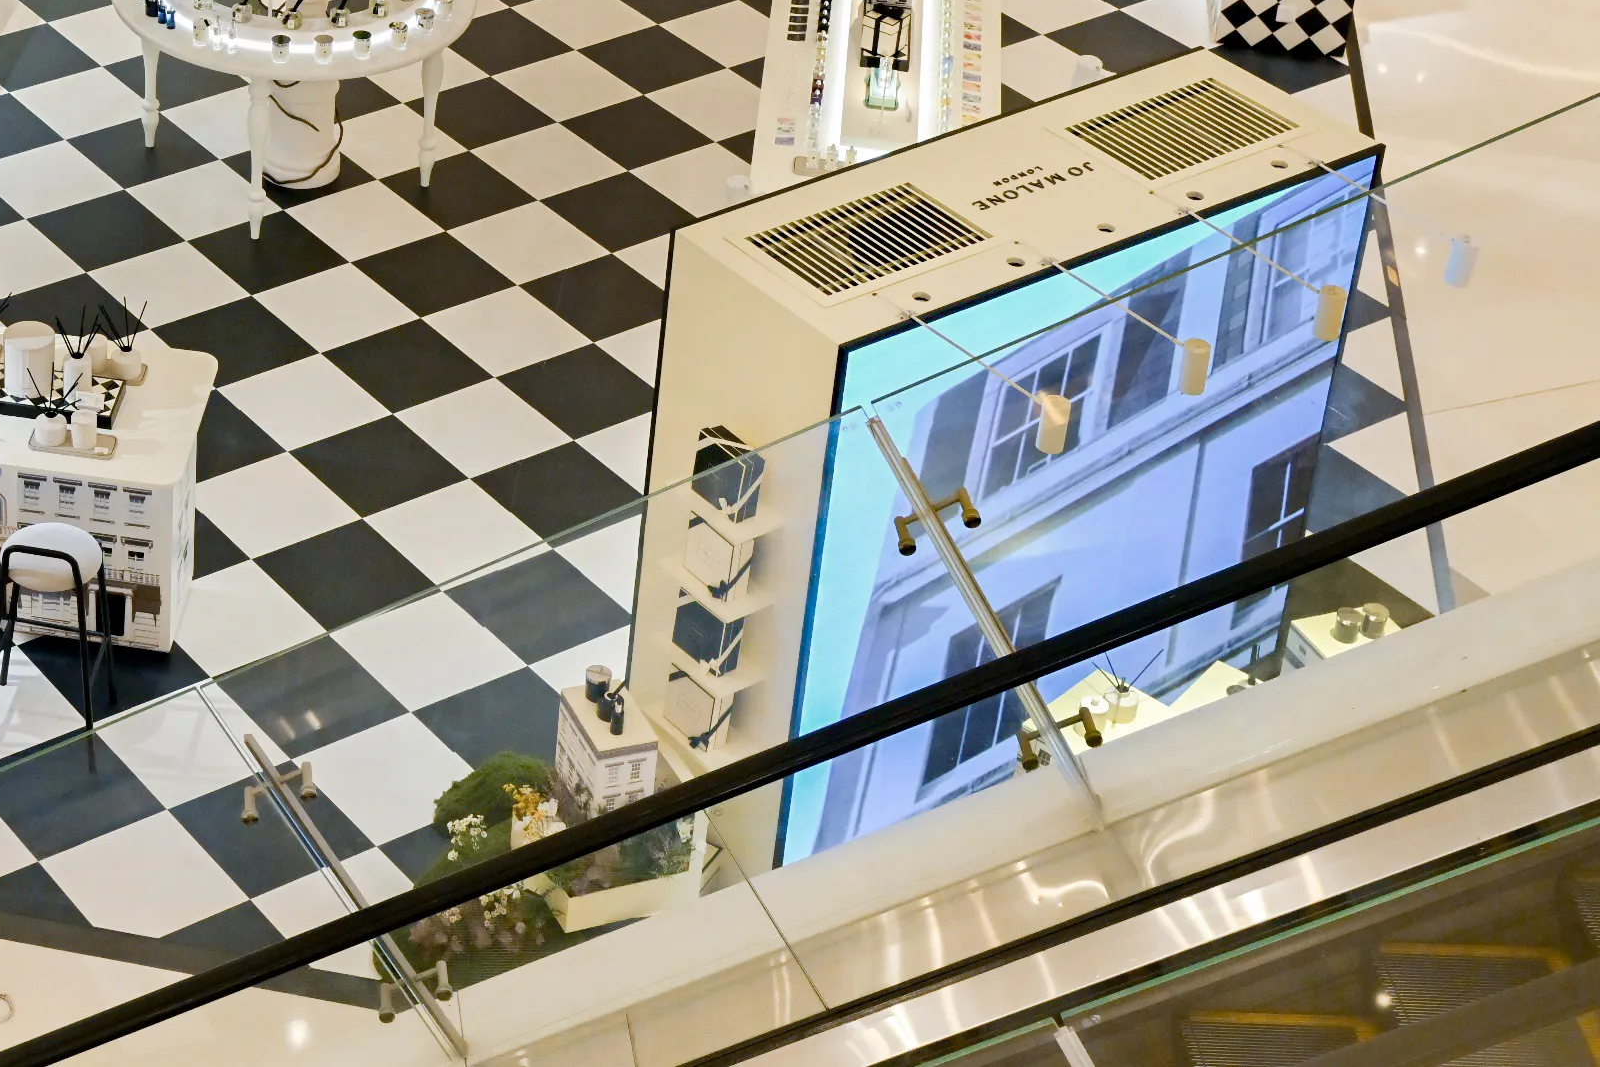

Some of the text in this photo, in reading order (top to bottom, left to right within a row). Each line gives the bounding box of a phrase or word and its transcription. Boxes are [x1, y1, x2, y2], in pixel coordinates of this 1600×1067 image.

[971, 161, 1094, 211] JO MALONE
[992, 165, 1044, 187] LONDON
